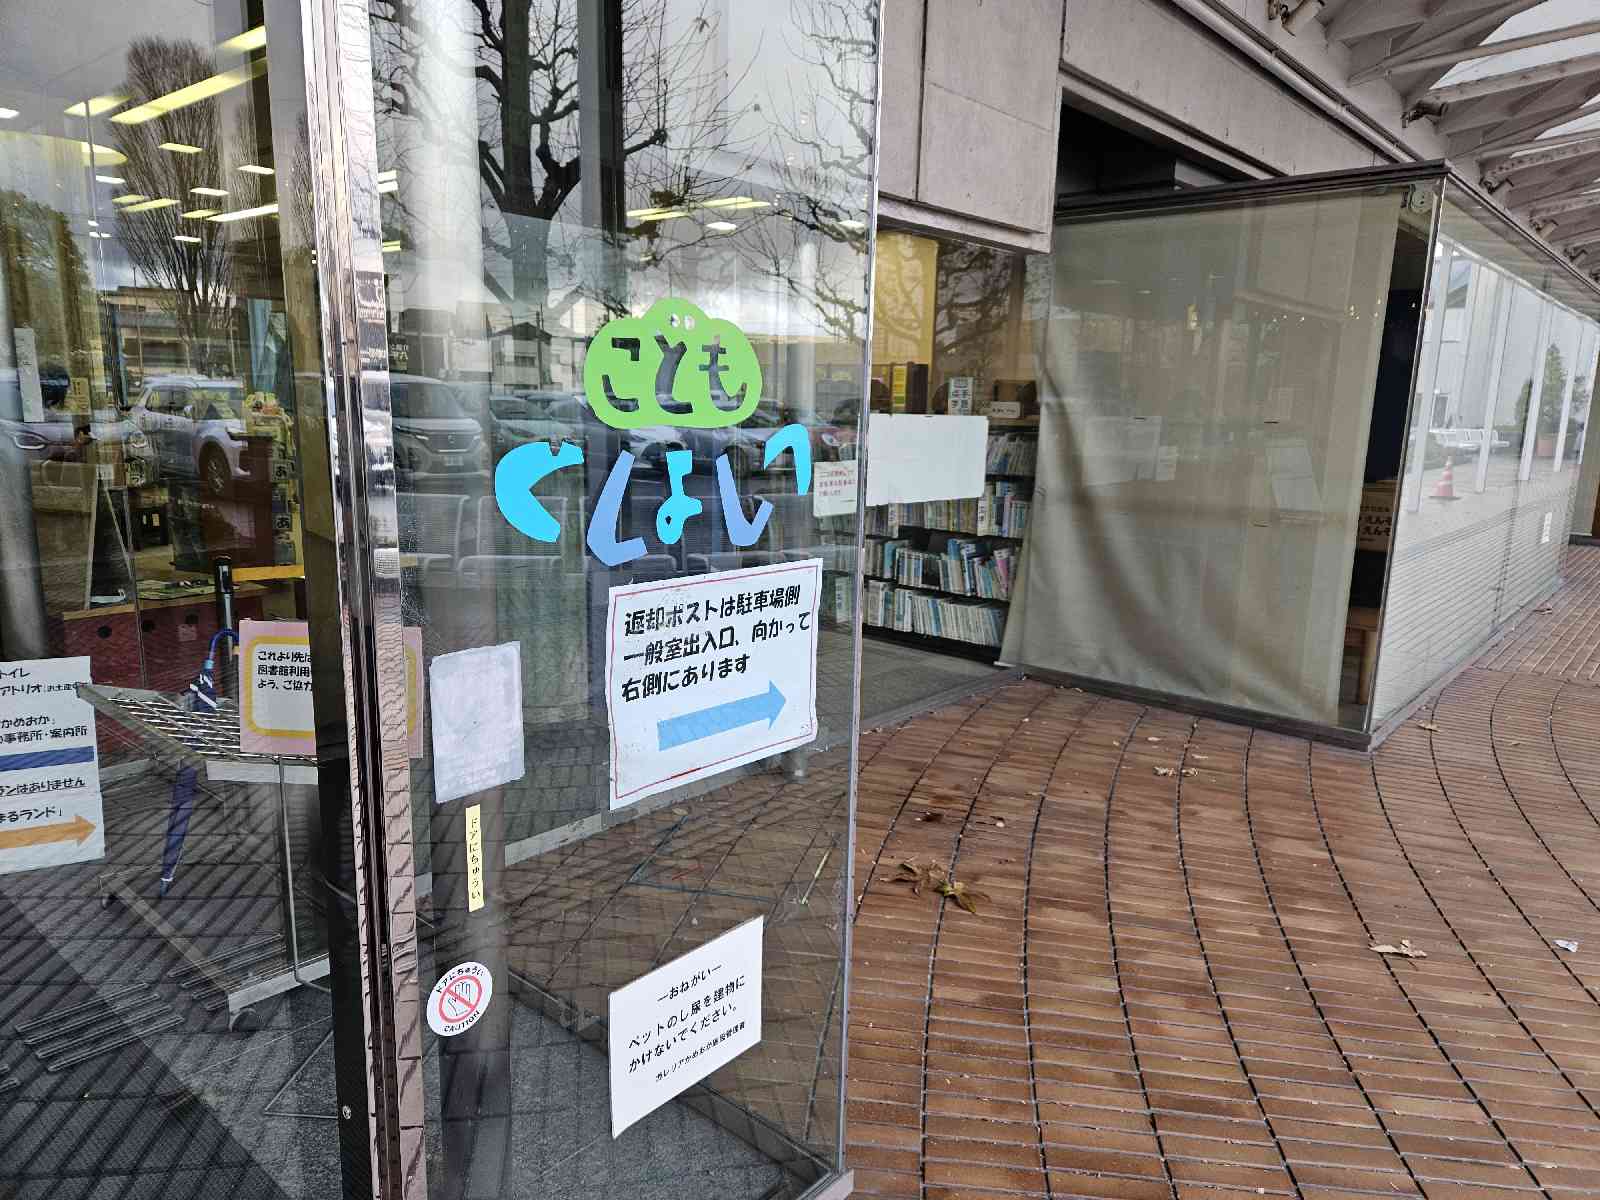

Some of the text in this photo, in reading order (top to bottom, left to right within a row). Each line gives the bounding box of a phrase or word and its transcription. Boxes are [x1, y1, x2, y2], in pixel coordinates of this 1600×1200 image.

[601, 314, 748, 415] こども
[624, 584, 801, 637] 返却ポストは駐車場側
[621, 653, 750, 703] 右側にあります
[443, 1009, 481, 1033] CAUTION
[628, 975, 746, 1050] ペットのし尿を建物に
[628, 1002, 738, 1074] かけないでください。
